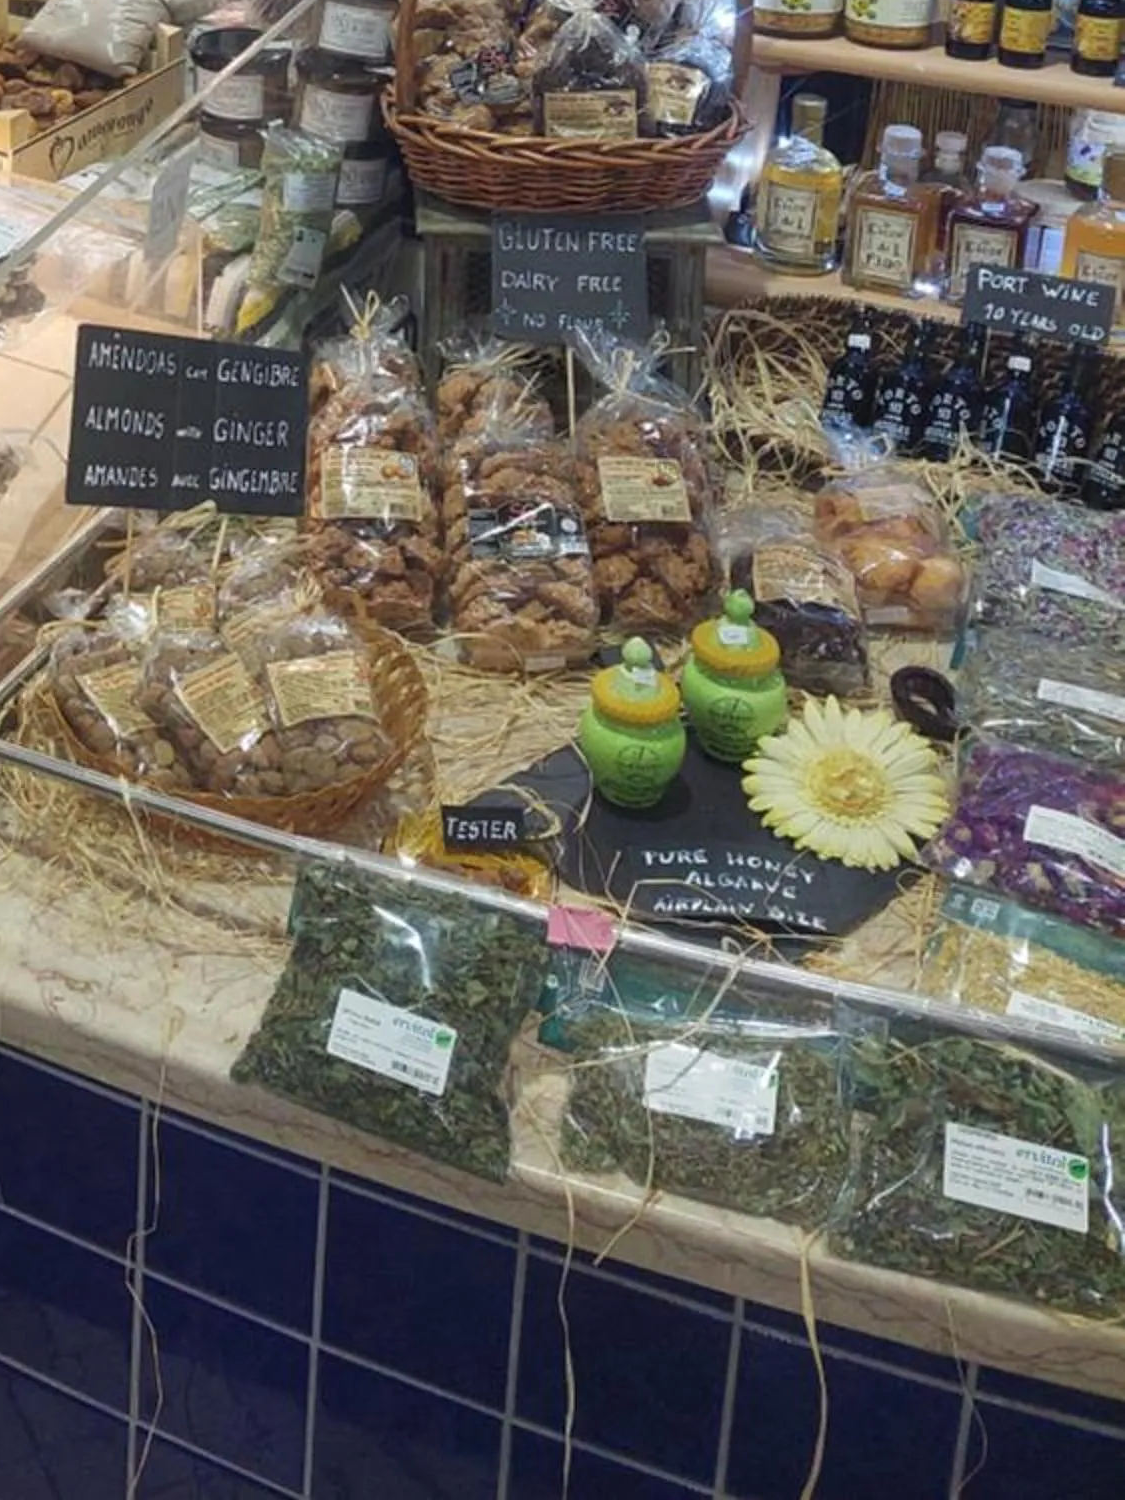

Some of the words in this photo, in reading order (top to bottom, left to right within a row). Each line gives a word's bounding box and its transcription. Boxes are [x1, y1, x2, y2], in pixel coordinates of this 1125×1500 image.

[498, 222, 579, 252] GLUTEN
[588, 231, 638, 253] FREE
[501, 269, 560, 293] DAIRY
[577, 275, 623, 293] FREE
[978, 268, 1029, 295] PORT
[1042, 280, 1101, 308] WINE
[522, 312, 547, 329] NO
[984, 303, 1006, 322] 10
[1010, 308, 1058, 334] YEARS
[1067, 323, 1105, 342] OLD
[216, 357, 300, 388] GENGIBRE
[84, 405, 167, 440] ALMONDS
[213, 414, 291, 447] GINGER
[83, 463, 160, 488] AMANDES
[208, 462, 299, 496] GINGEMBRE
[446, 815, 519, 841] TESTER
[643, 849, 709, 867] PURE
[727, 852, 816, 884] HONEY
[684, 870, 797, 900] ALGARVE
